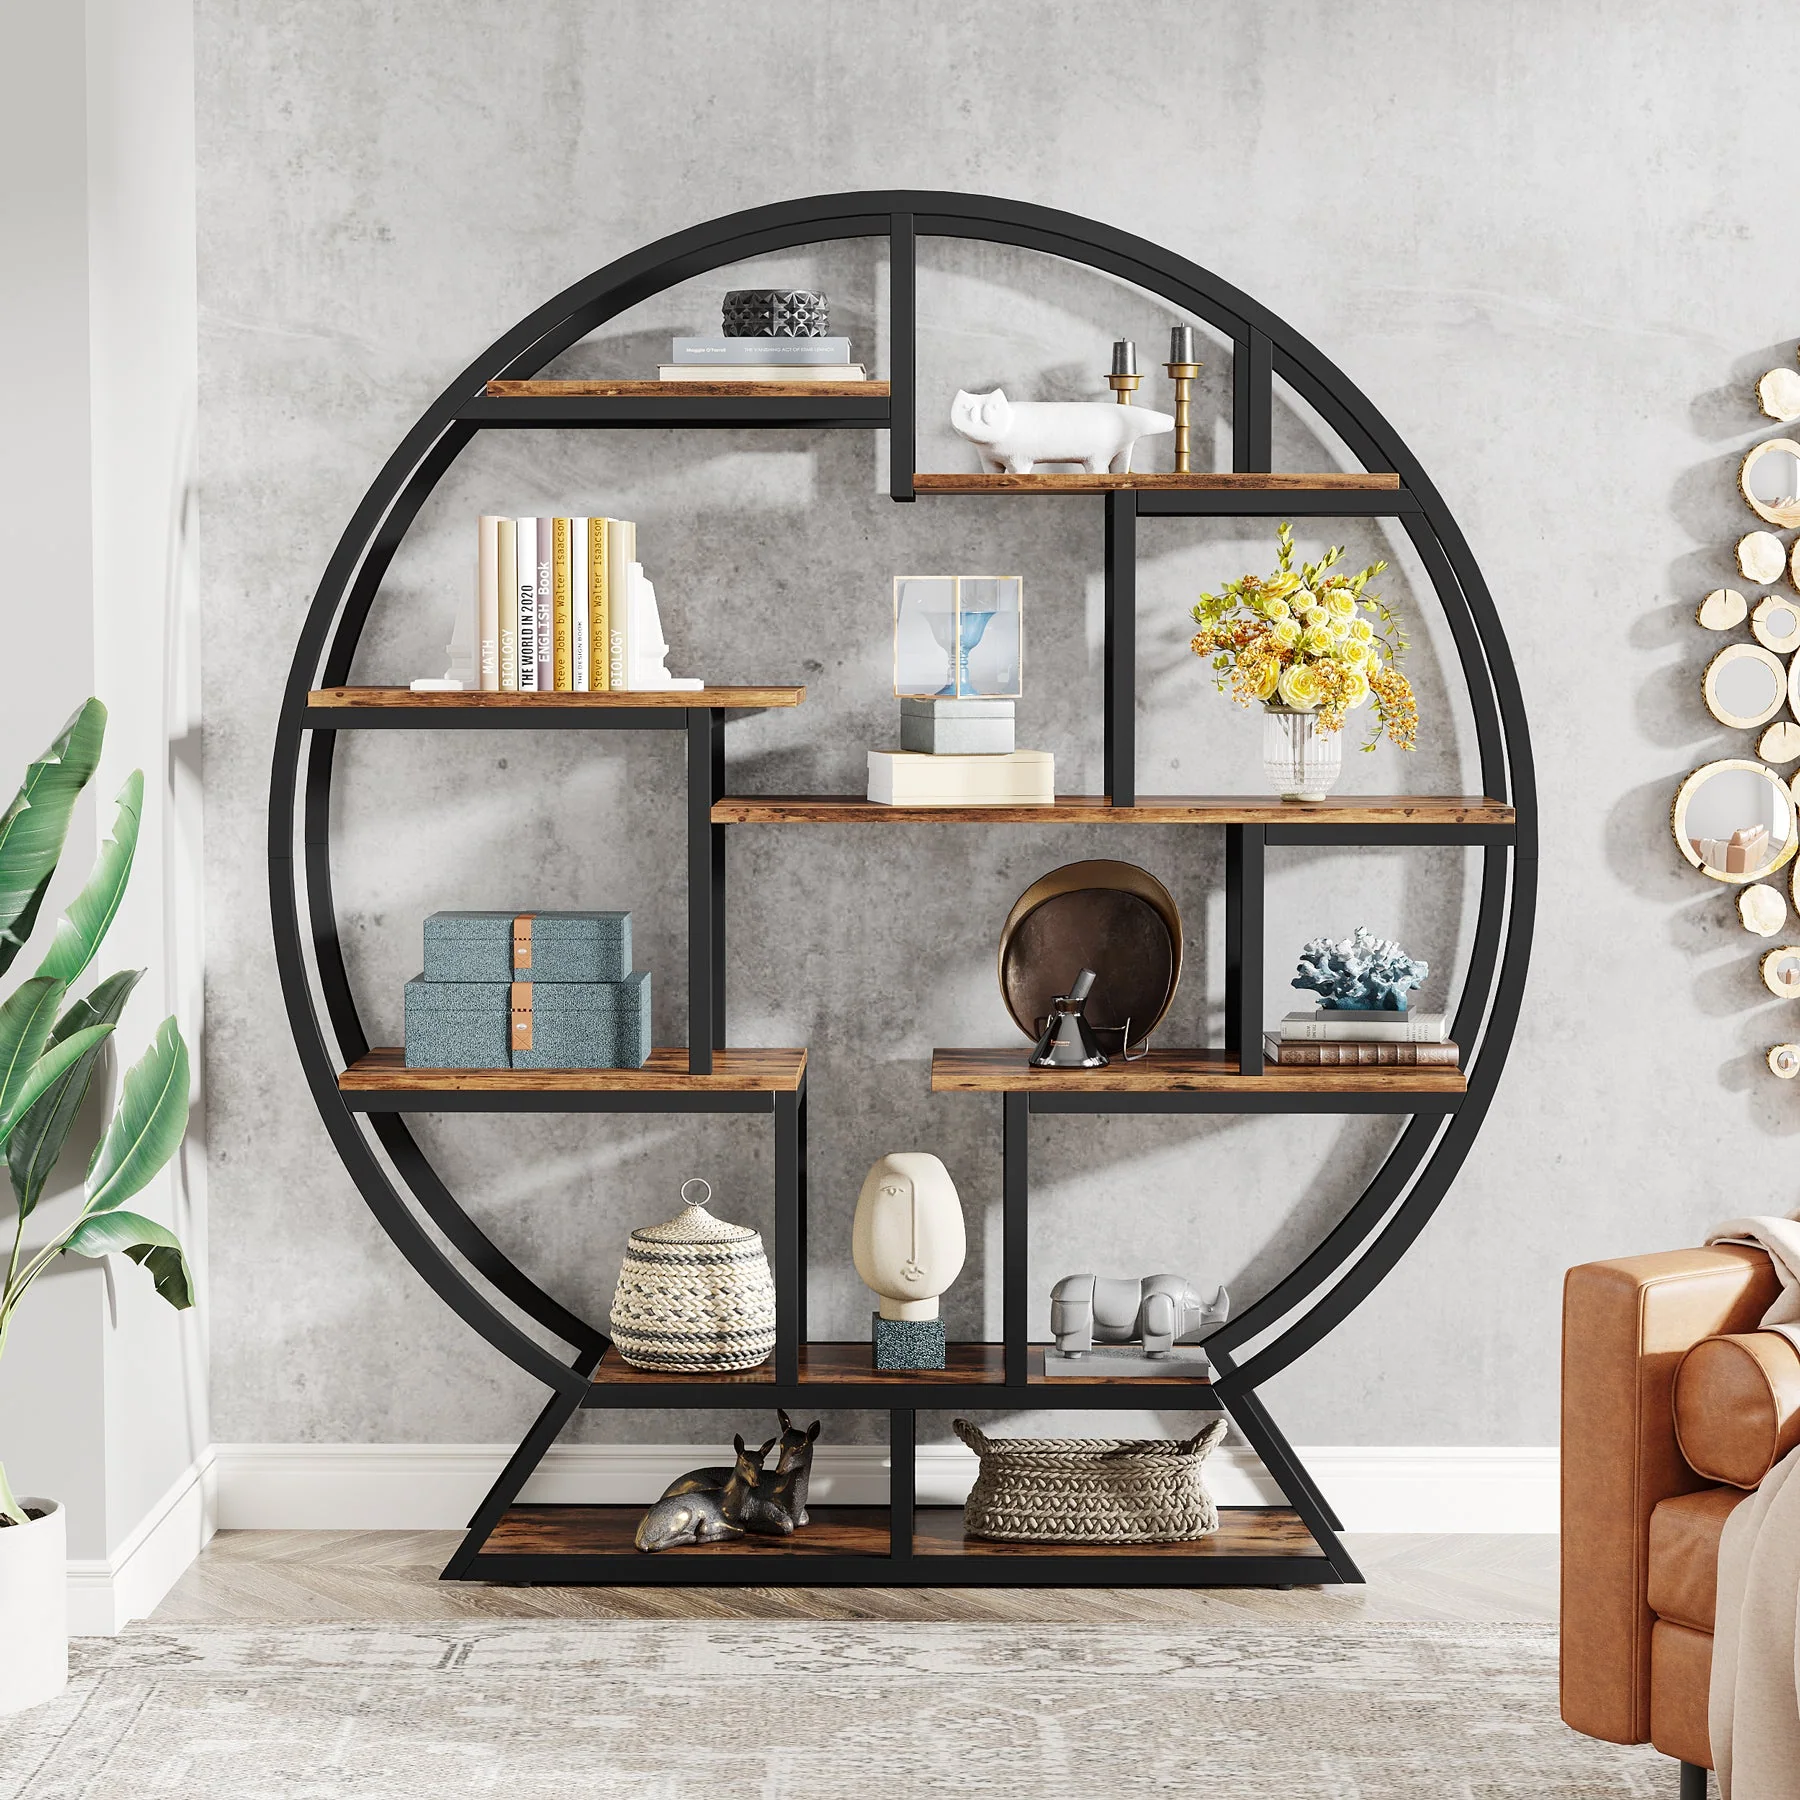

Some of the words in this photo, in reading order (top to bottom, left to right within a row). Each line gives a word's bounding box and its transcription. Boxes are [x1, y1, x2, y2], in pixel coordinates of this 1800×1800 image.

[556, 519, 566, 565] Isaacson
[593, 519, 603, 565] Isaacson
[537, 561, 550, 595] Book
[556, 573, 566, 608] Walter
[593, 573, 603, 608] Walter
[521, 585, 534, 612] 2020
[521, 615, 534, 626] IN
[538, 603, 550, 663] ENGLISH
[556, 612, 568, 624] by
[593, 612, 605, 624] by
[482, 639, 495, 675] MATH
[502, 629, 514, 687] BIOLOGY
[521, 628, 534, 666] WORLD
[556, 630, 566, 652] Jobs
[593, 630, 603, 652] Jobs
[610, 629, 623, 687] BIOLOGY
[521, 667, 534, 688] THE
[556, 659, 566, 688] Steve
[593, 659, 603, 688] Steve
